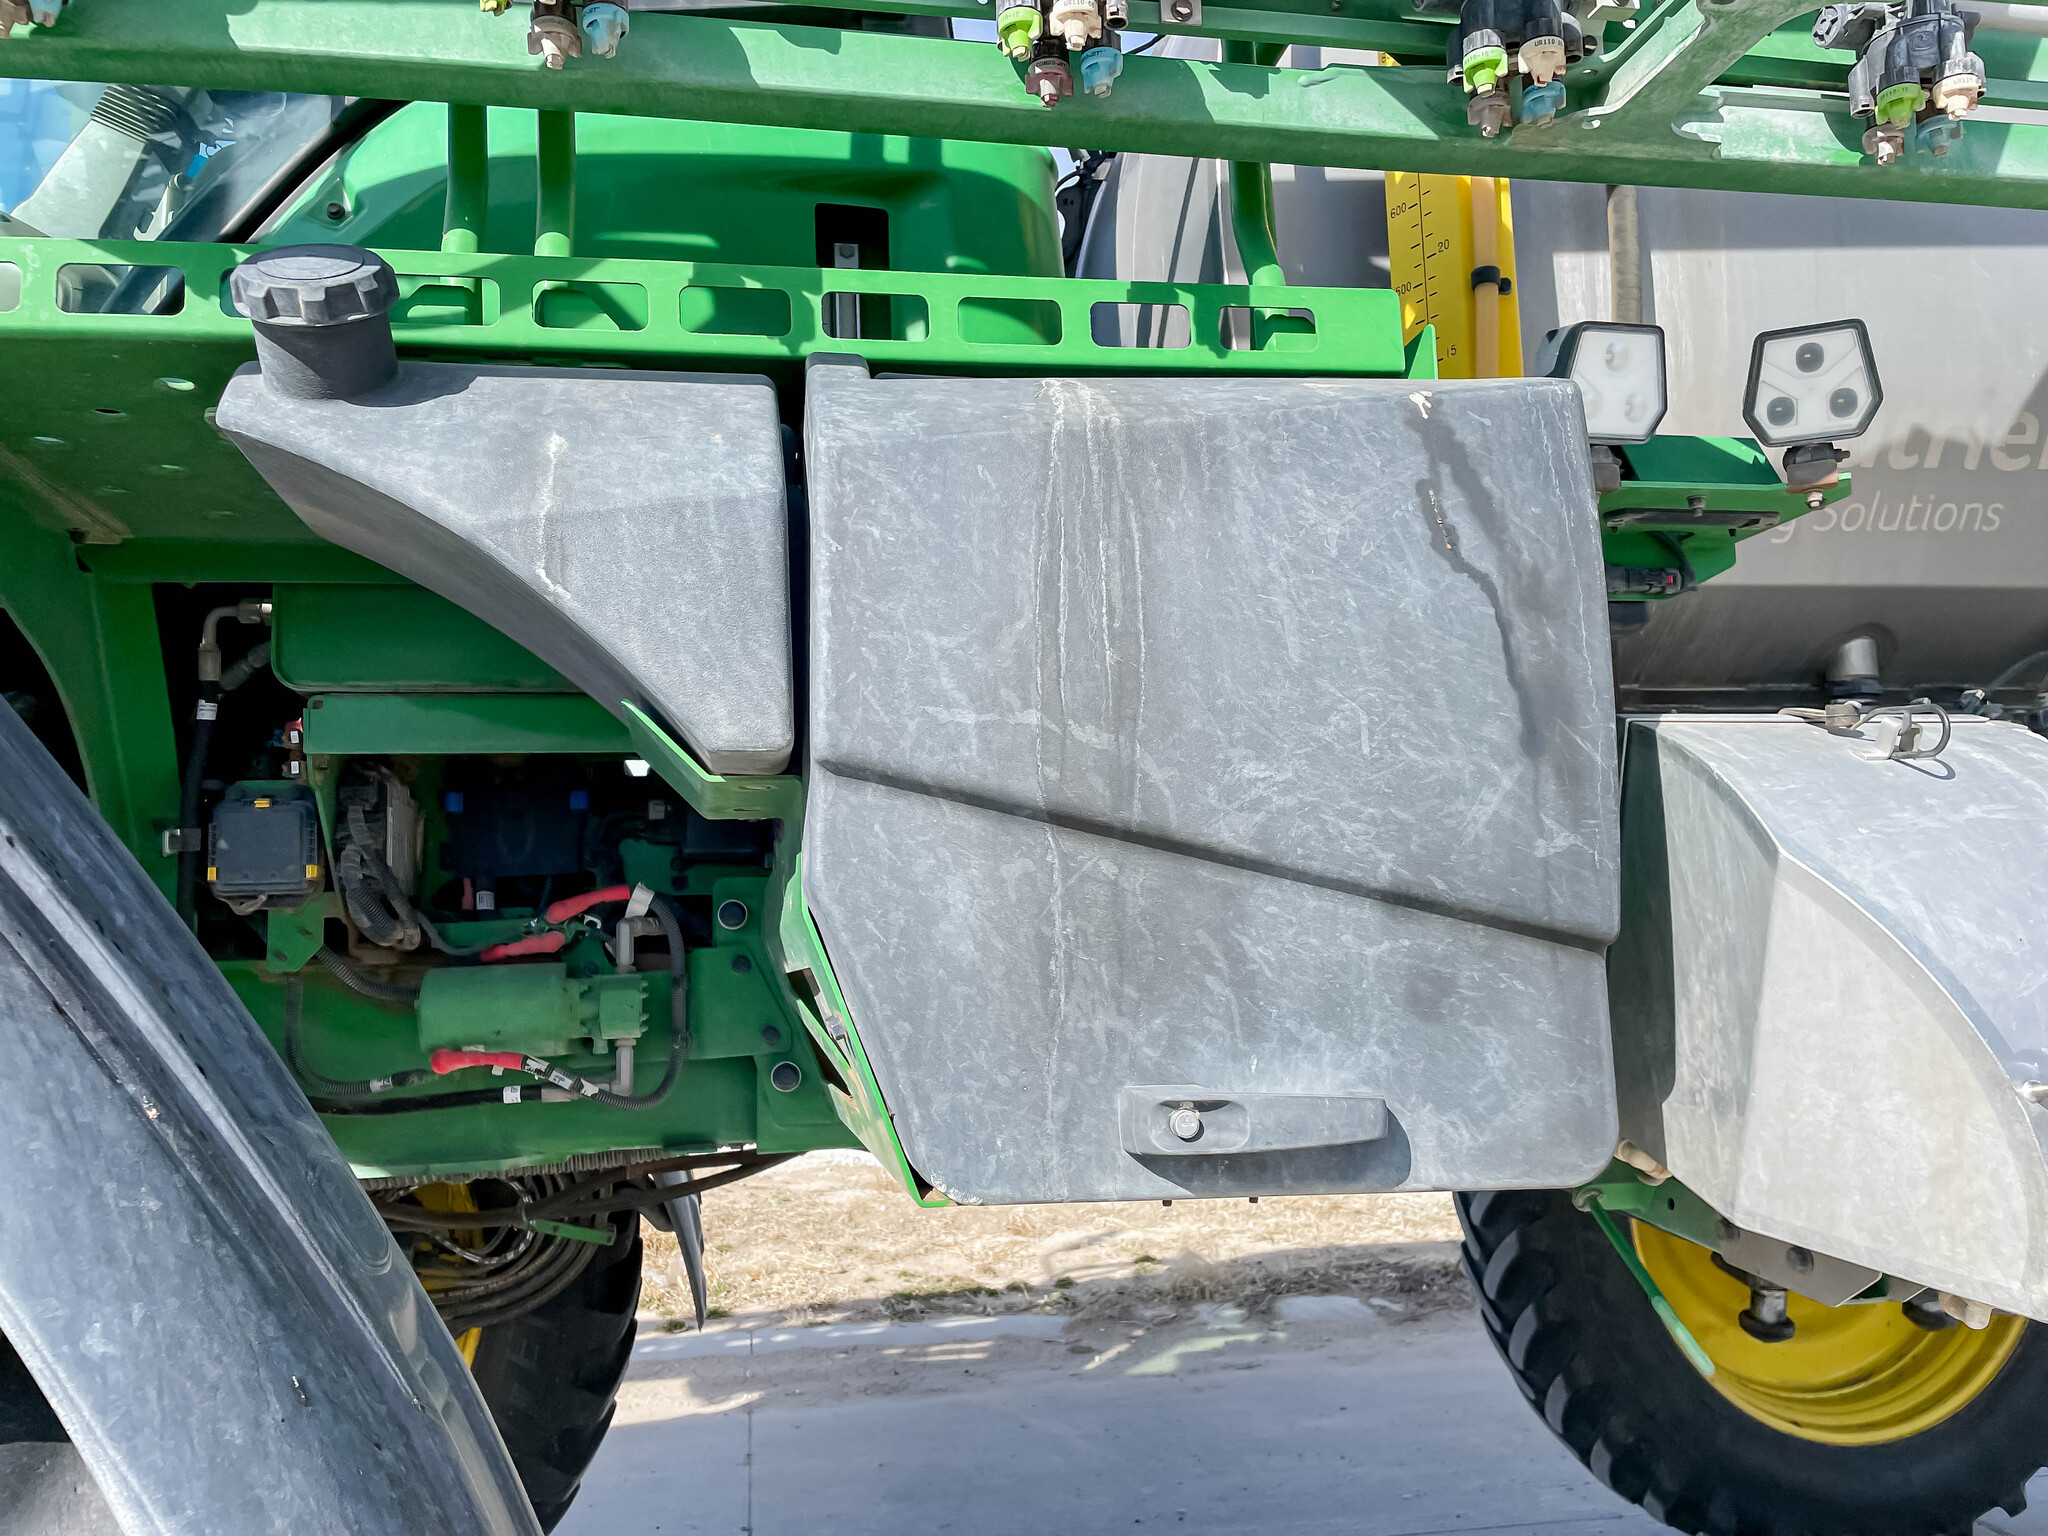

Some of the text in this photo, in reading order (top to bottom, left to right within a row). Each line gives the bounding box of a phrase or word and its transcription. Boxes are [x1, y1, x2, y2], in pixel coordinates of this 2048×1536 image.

[1390, 202, 1407, 219] 600
[1437, 238, 1450, 253] 20
[1395, 281, 1412, 296] 500
[1446, 344, 1457, 359] 15
[1812, 490, 2004, 534] Solutions
